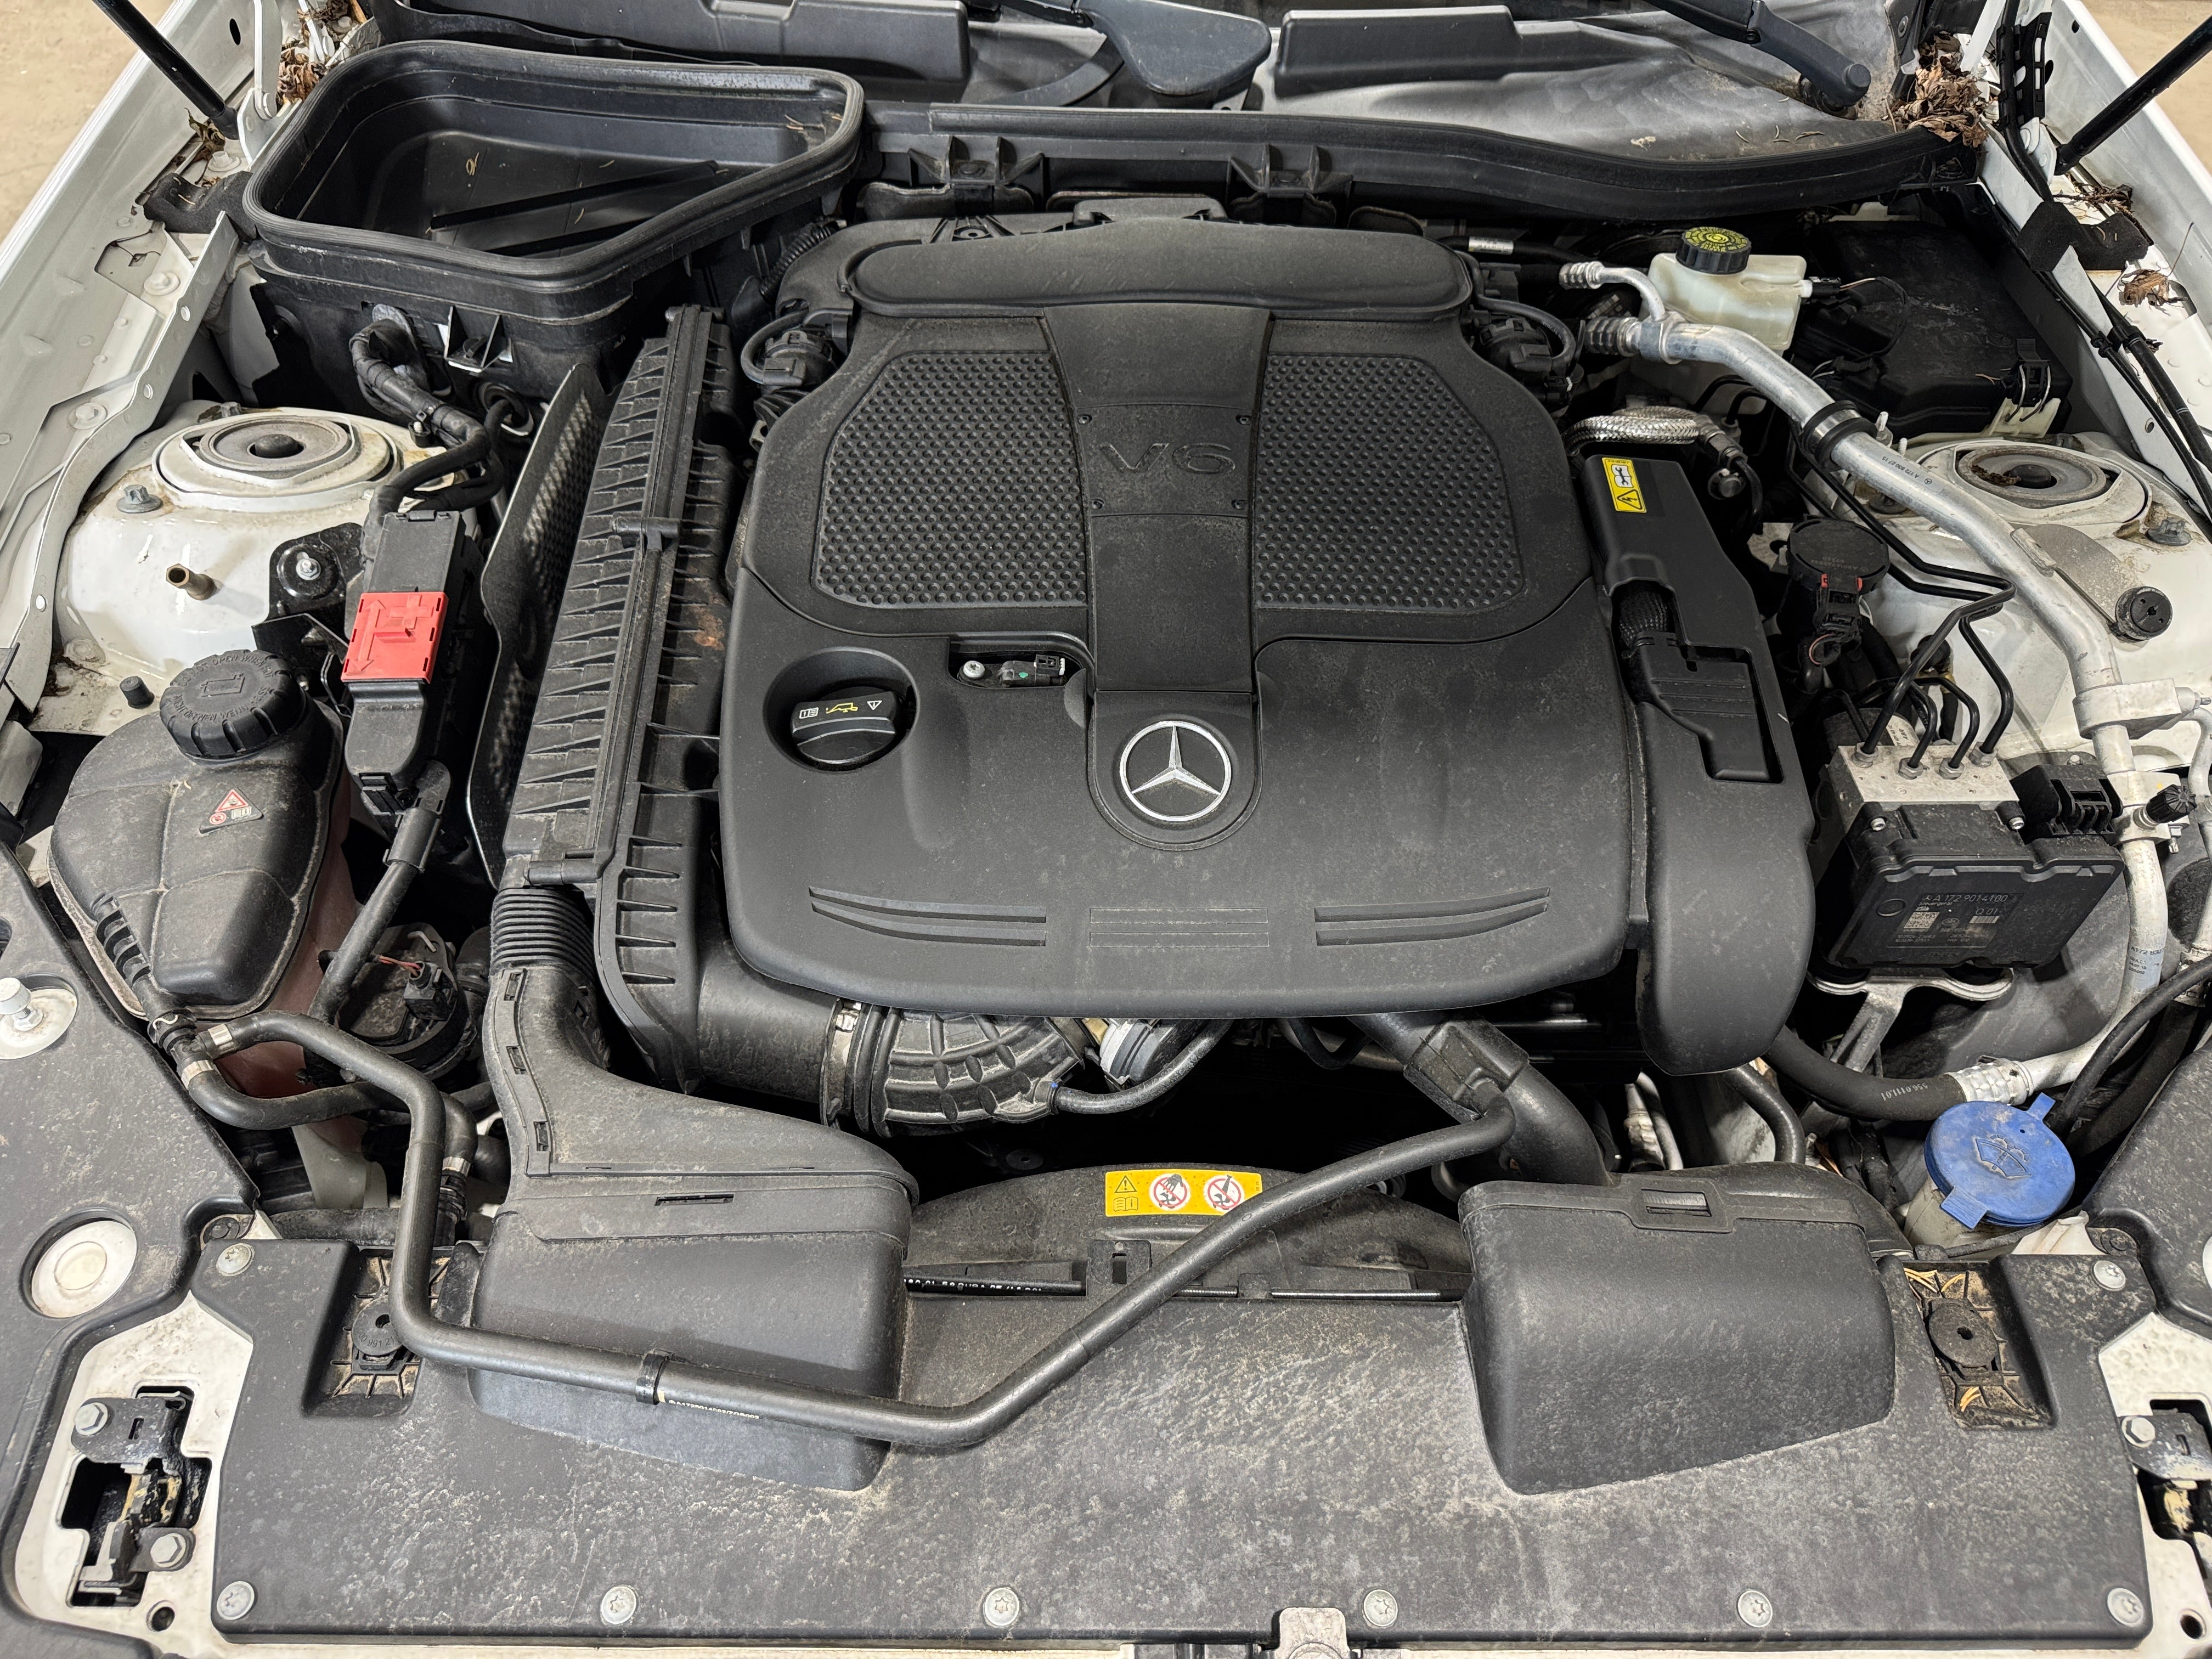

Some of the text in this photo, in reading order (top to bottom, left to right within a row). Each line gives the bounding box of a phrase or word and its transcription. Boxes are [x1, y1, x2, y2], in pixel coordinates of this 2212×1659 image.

[1099, 442, 1236, 475] V6
[212, 654, 239, 665] OPEN
[367, 1339, 382, 1348] 991
